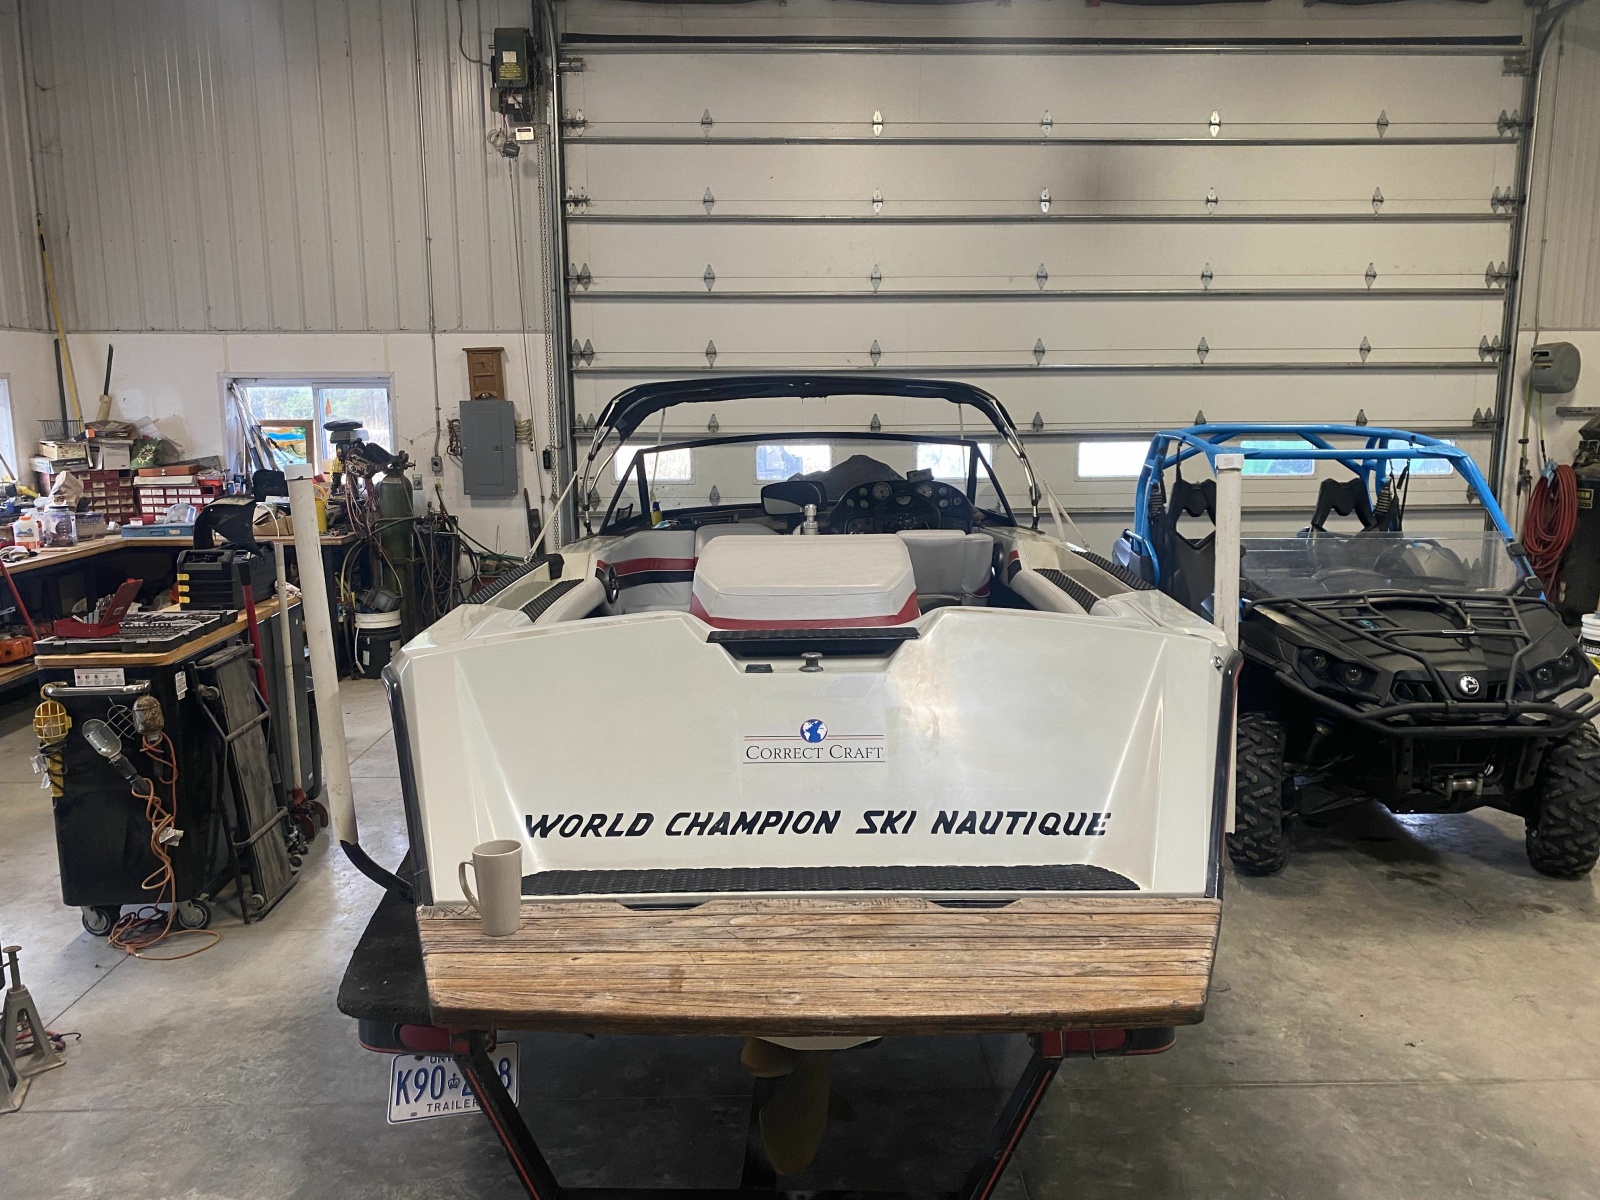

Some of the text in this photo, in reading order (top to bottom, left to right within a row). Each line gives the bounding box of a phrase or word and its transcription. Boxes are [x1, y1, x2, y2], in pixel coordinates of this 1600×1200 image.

[745, 744, 884, 760] CORRECT CRAFT
[524, 810, 1112, 839] WORLD CHAMPION SKI NAUTIQUE
[395, 1065, 447, 1106] K90
